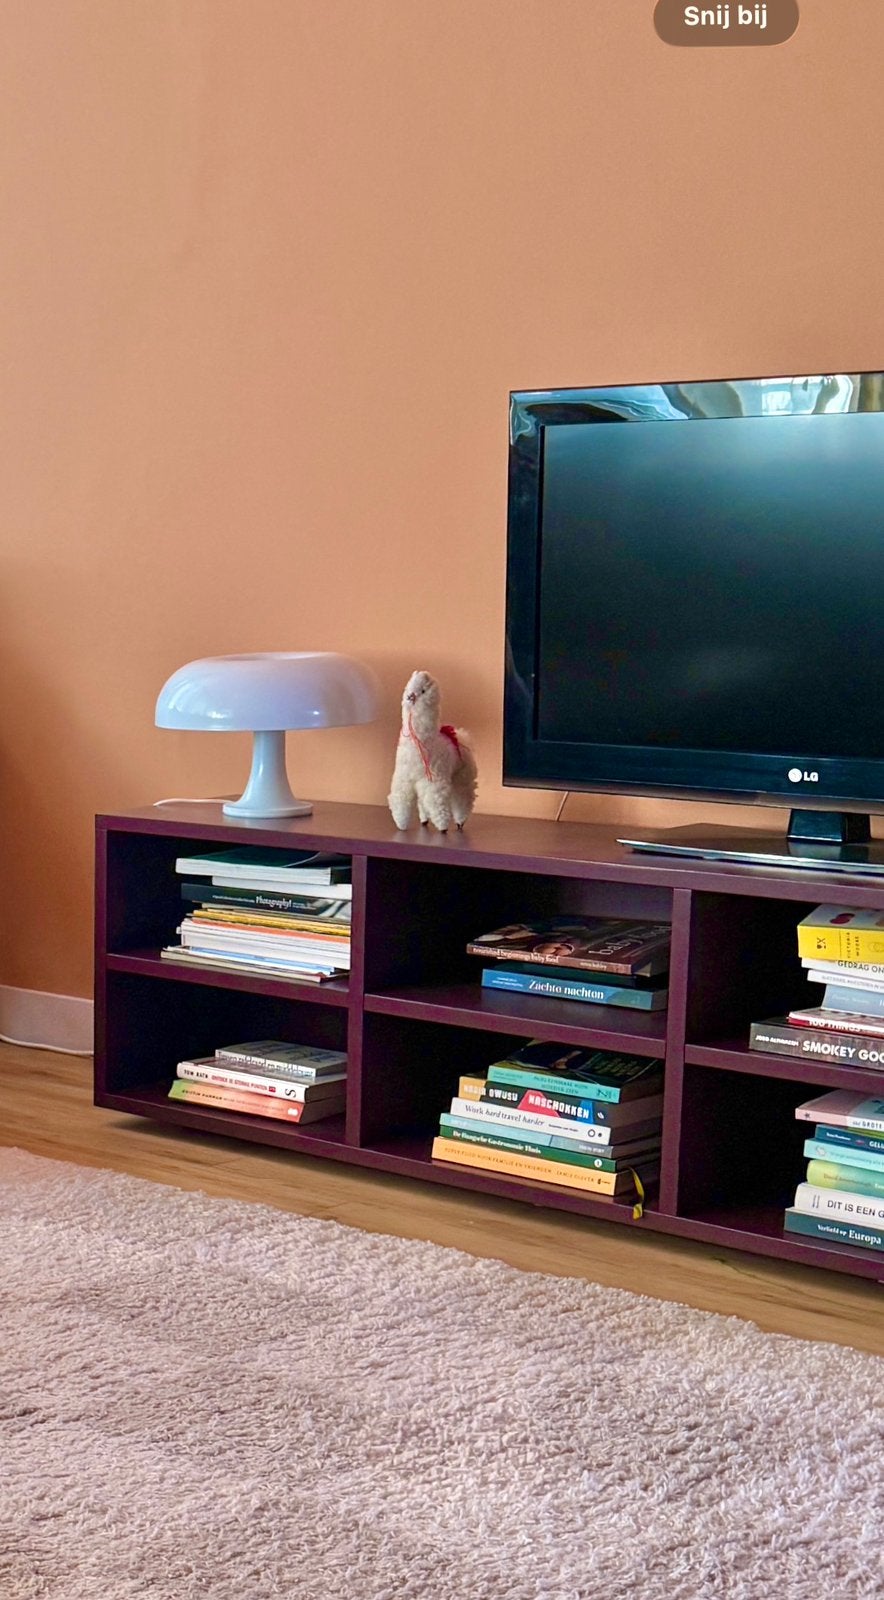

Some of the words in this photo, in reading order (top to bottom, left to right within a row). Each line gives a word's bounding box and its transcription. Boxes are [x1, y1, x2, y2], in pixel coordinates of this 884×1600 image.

[803, 771, 819, 782] LG
[837, 959, 870, 971] GEDRAG
[564, 985, 604, 1000] nachten
[802, 1040, 856, 1058] SMOKEY
[488, 1088, 518, 1101] OWUSU
[528, 1094, 590, 1119] NASCHOKKEN
[465, 1105, 484, 1115] Work
[485, 1109, 501, 1118] hard
[501, 1113, 521, 1122] travel
[523, 1115, 545, 1126] harder
[827, 1199, 842, 1210] DIT
[844, 1203, 854, 1212] IS
[856, 1205, 876, 1216] EEN
[848, 1229, 882, 1246] Europa
